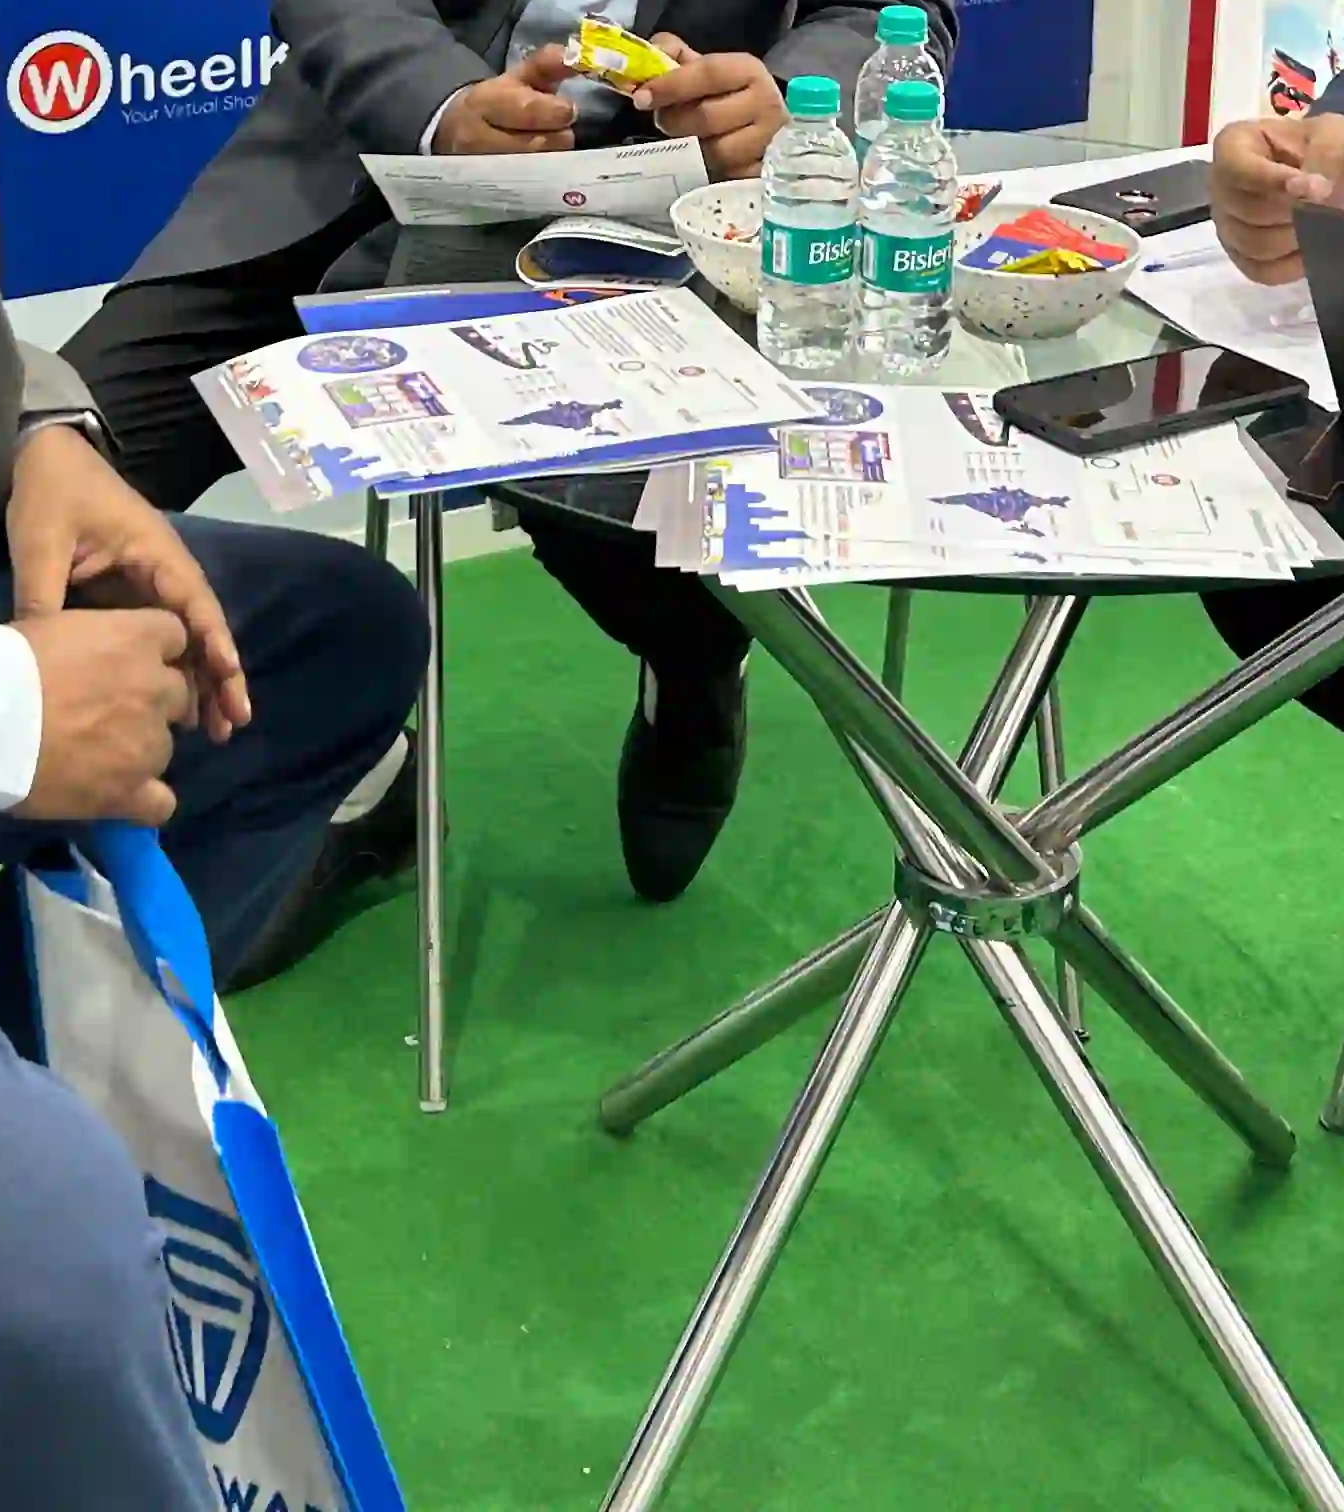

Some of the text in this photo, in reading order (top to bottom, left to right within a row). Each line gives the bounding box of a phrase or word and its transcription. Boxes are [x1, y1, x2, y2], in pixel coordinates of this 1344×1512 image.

[26, 35, 290, 116] WheelK
[121, 108, 158, 126] Your
[164, 98, 219, 120] Virtual
